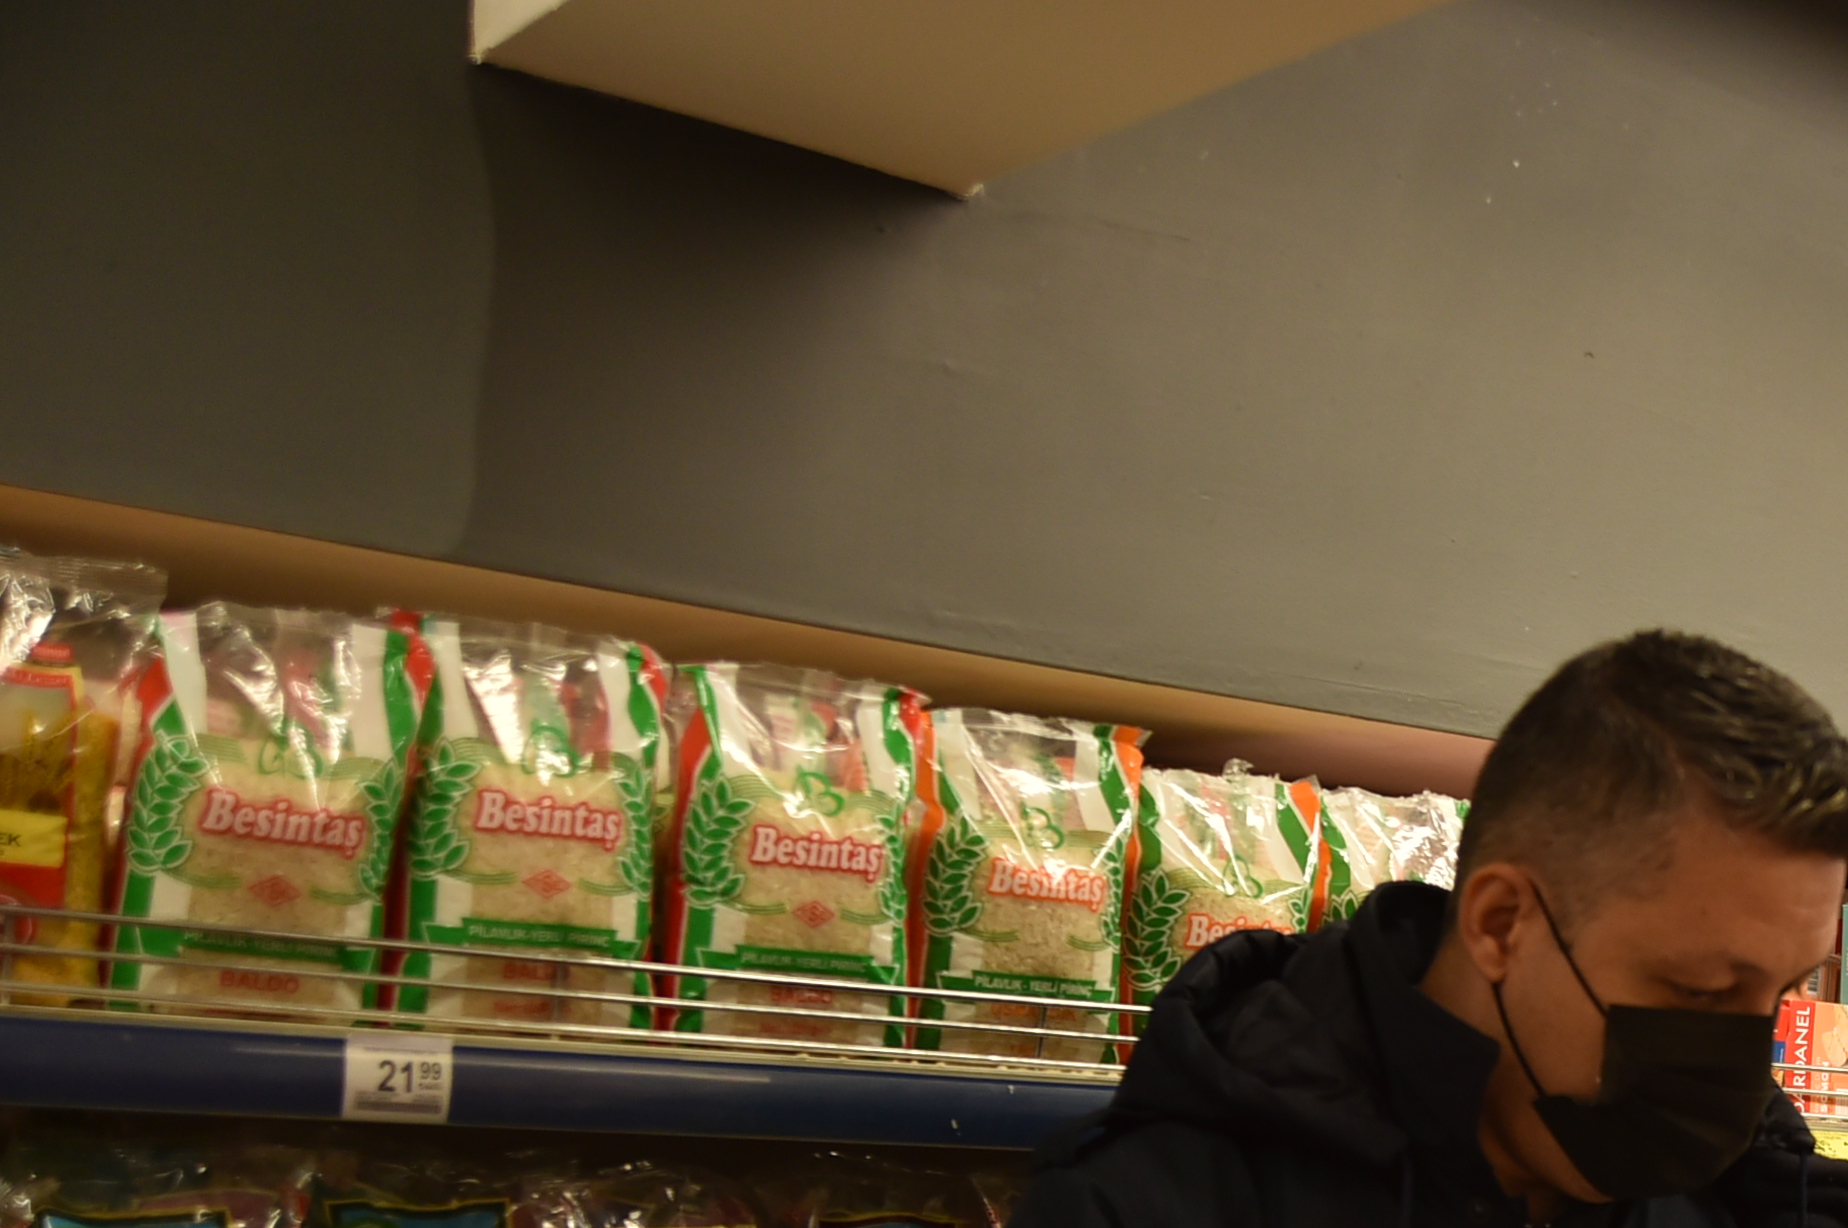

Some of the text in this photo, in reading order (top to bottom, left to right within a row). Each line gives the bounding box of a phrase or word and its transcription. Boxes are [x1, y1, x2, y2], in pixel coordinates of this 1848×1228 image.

[200, 790, 366, 858] Besintaş
[474, 790, 623, 851] Besintaş
[749, 822, 885, 882] Besintaş
[378, 1060, 443, 1093] 21 99
